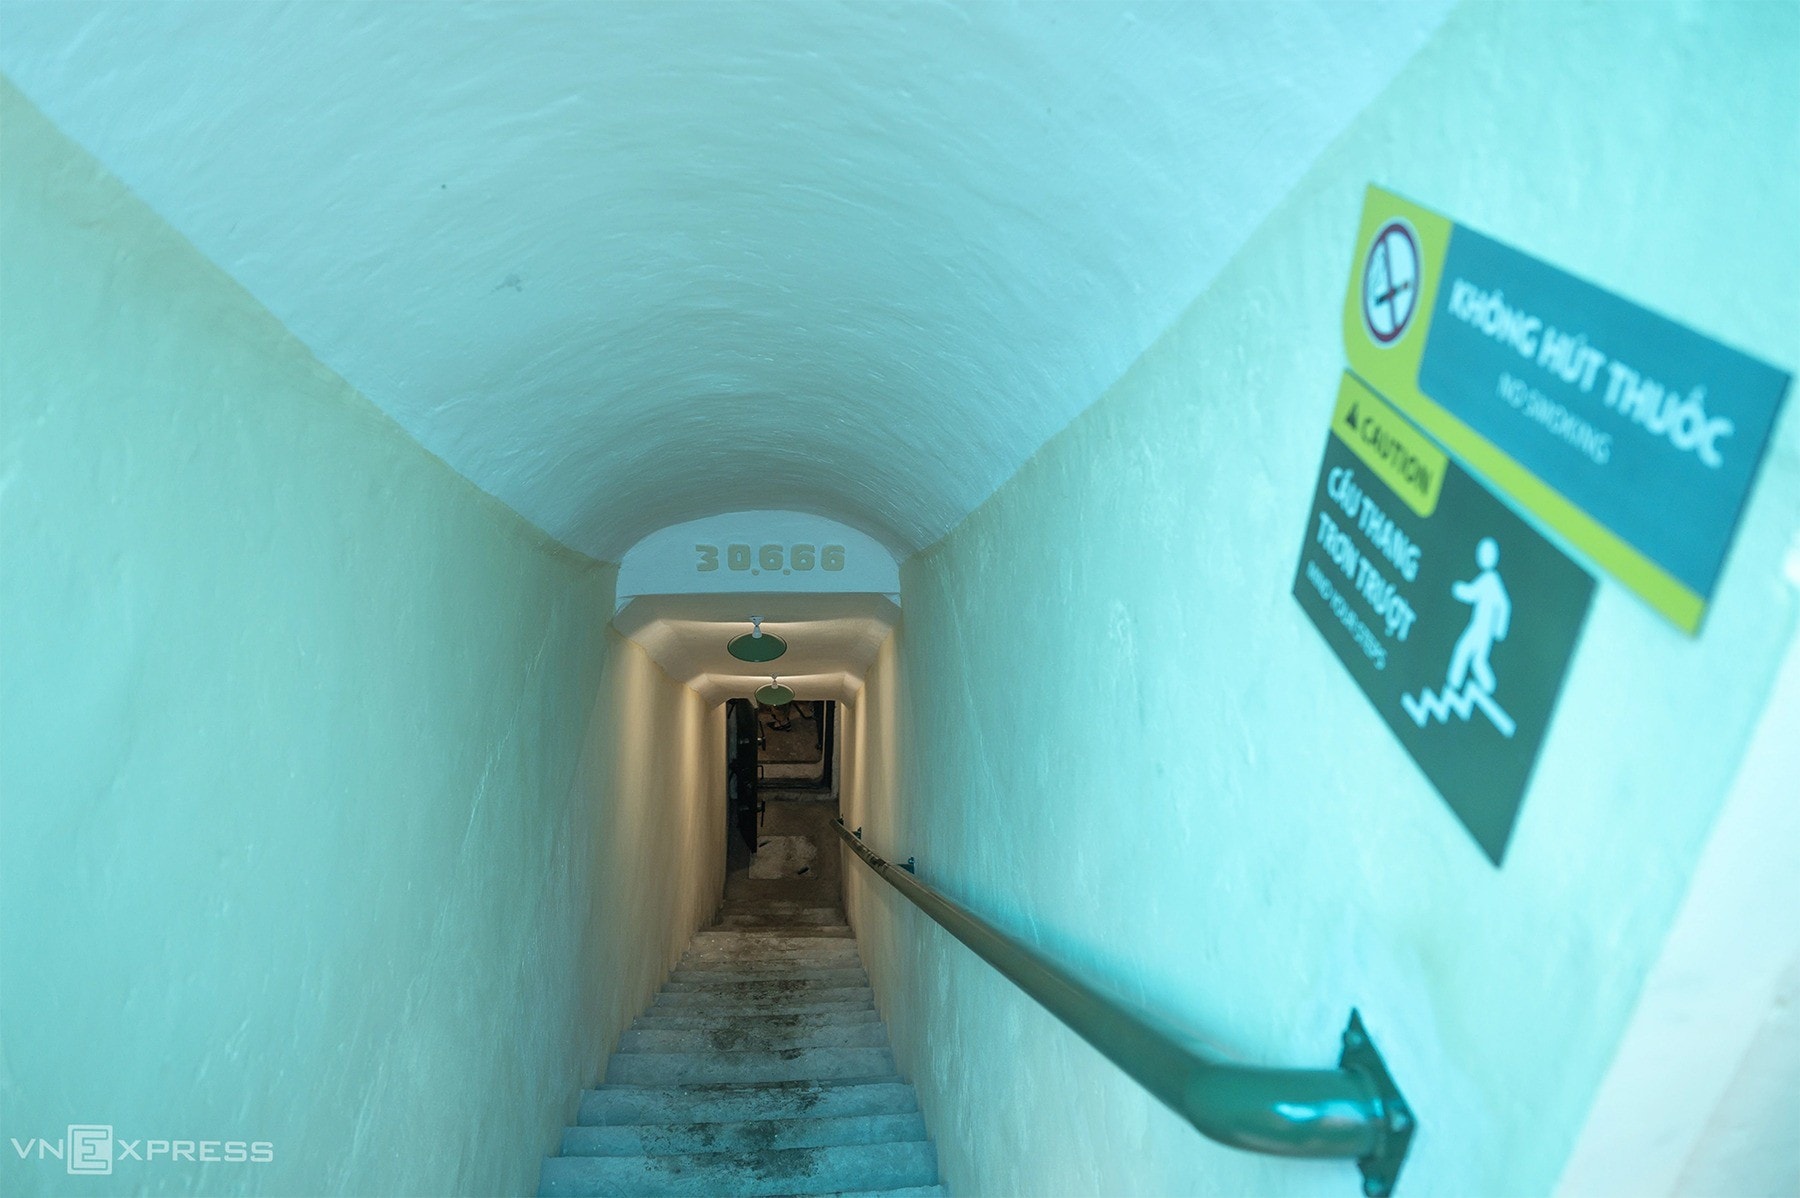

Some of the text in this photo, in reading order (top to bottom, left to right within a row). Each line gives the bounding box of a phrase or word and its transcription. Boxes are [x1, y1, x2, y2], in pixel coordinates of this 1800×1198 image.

[1449, 278, 1734, 468] KHÔNG HÚT THUỐC
[1361, 416, 1434, 497] CAUTION
[1496, 373, 1613, 465] NO SMOKING
[695, 543, 846, 576] 30.6.66
[1358, 495, 1421, 582] THANG
